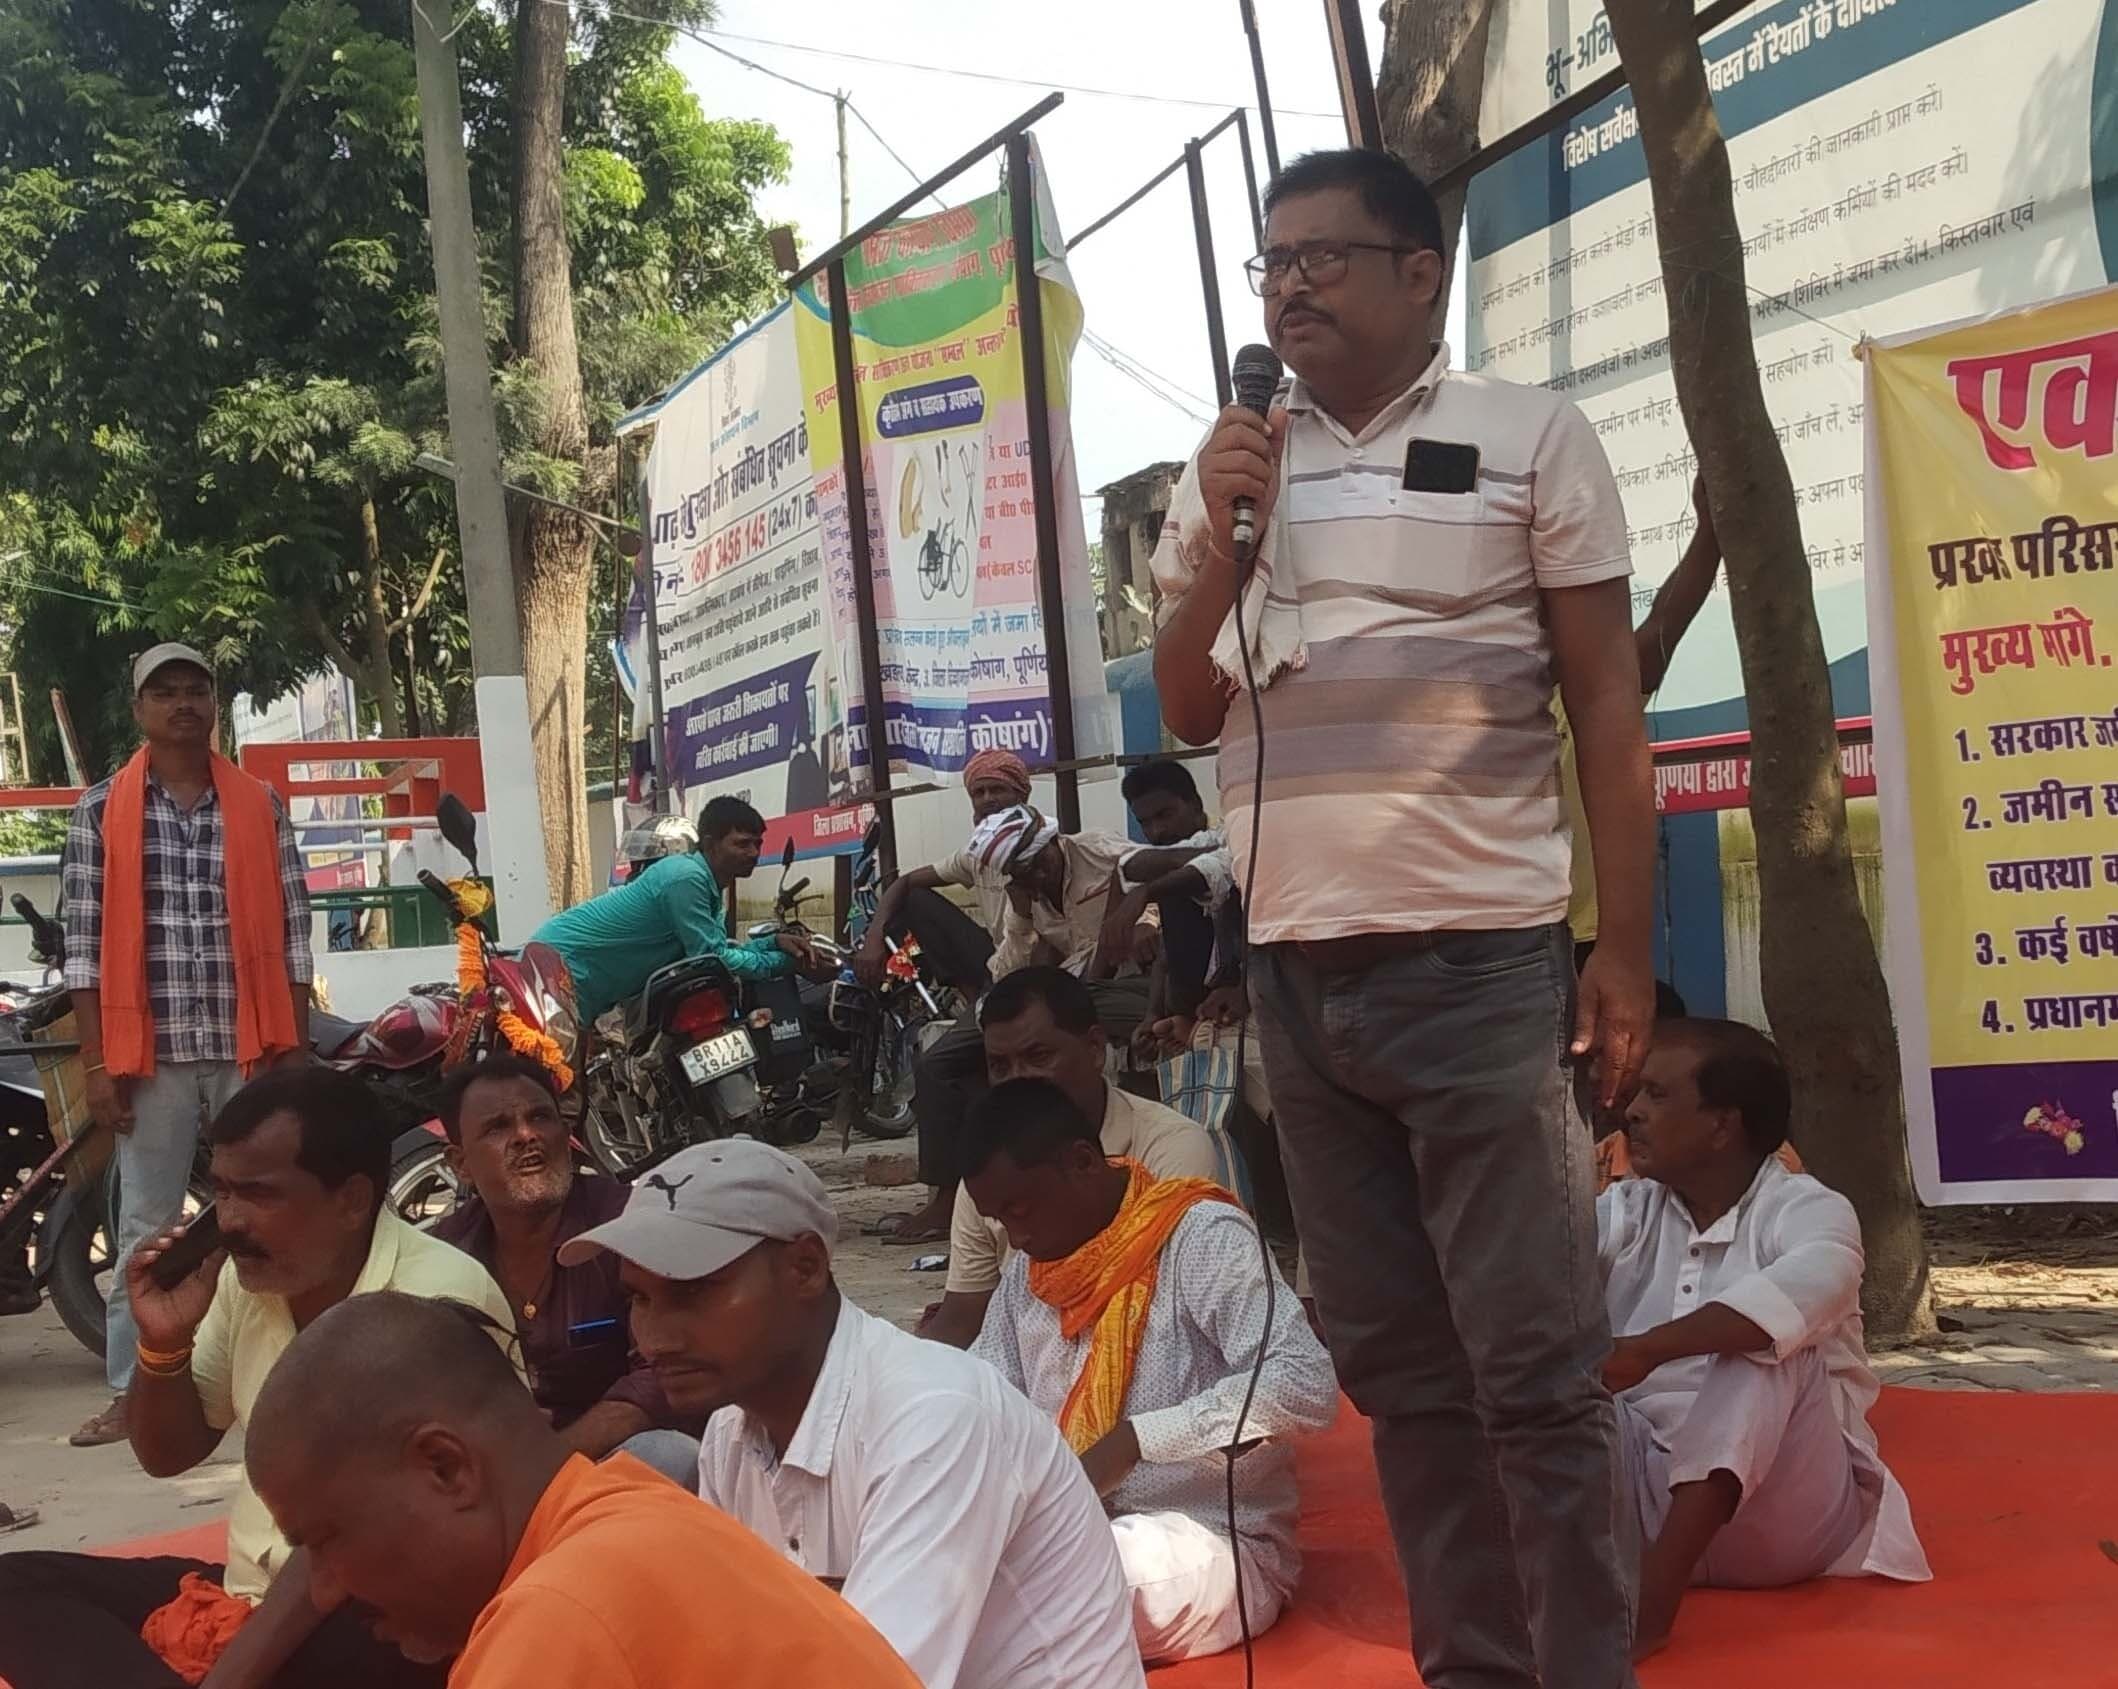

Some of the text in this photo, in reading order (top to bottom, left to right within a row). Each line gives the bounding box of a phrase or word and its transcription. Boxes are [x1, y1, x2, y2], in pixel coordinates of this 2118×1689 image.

[1545, 12, 1616, 99] भू-अभि
[1562, 126, 1598, 172] विशेष
[1600, 105, 1640, 152] सर्वेक्ष
[1746, 30, 1764, 72] में
[1813, 2, 1833, 39] के
[1804, 135, 1821, 164] की
[1825, 110, 1881, 154] जानकारी
[1885, 101, 1912, 131] प्राप्त
[1635, 276, 1664, 299] सत्या
[1788, 207, 1830, 240] सर्वेक्षण
[1880, 172, 1901, 201] की
[1906, 165, 1936, 192] मदद
[1793, 273, 1830, 307] शिविर
[1833, 263, 1844, 291] में
[1846, 259, 1874, 285] जमा
[1878, 250, 1900, 275] कर
[1938, 211, 2006, 256] किस्तवार
[2009, 195, 2036, 231] एवं
[1765, 348, 1808, 383] सहयोग
[731, 445, 765, 500] संबंधित
[768, 427, 796, 490] सूचना
[798, 409, 808, 457] के
[1015, 440, 1031, 458] UD
[1808, 478, 1845, 504] अपना
[715, 526, 741, 571] 3456
[744, 511, 765, 555] 145
[767, 495, 802, 546] (24x7)
[1806, 544, 1830, 570] विर
[1832, 539, 1845, 566] से
[2010, 515, 2118, 579] परिस
[1004, 613, 1029, 633] जमा
[970, 652, 1010, 682] कोषांग,
[1013, 644, 1049, 685] पूर्णिय
[1939, 624, 2035, 695] मुख्य
[778, 682, 790, 703] पर
[969, 711, 1048, 756] कोषांग)
[1955, 728, 1981, 762] 1.
[1988, 717, 2089, 757] सरकार
[1705, 760, 1737, 792] द्वारा
[1962, 797, 1992, 830] 2.
[1999, 779, 2093, 824] जमीन
[1986, 856, 2093, 893] व्यवस्था
[1975, 932, 2007, 965] 3.
[2015, 916, 2068, 964] कई
[1982, 1000, 2015, 1033] 4.
[692, 1033, 742, 1063] BR11A
